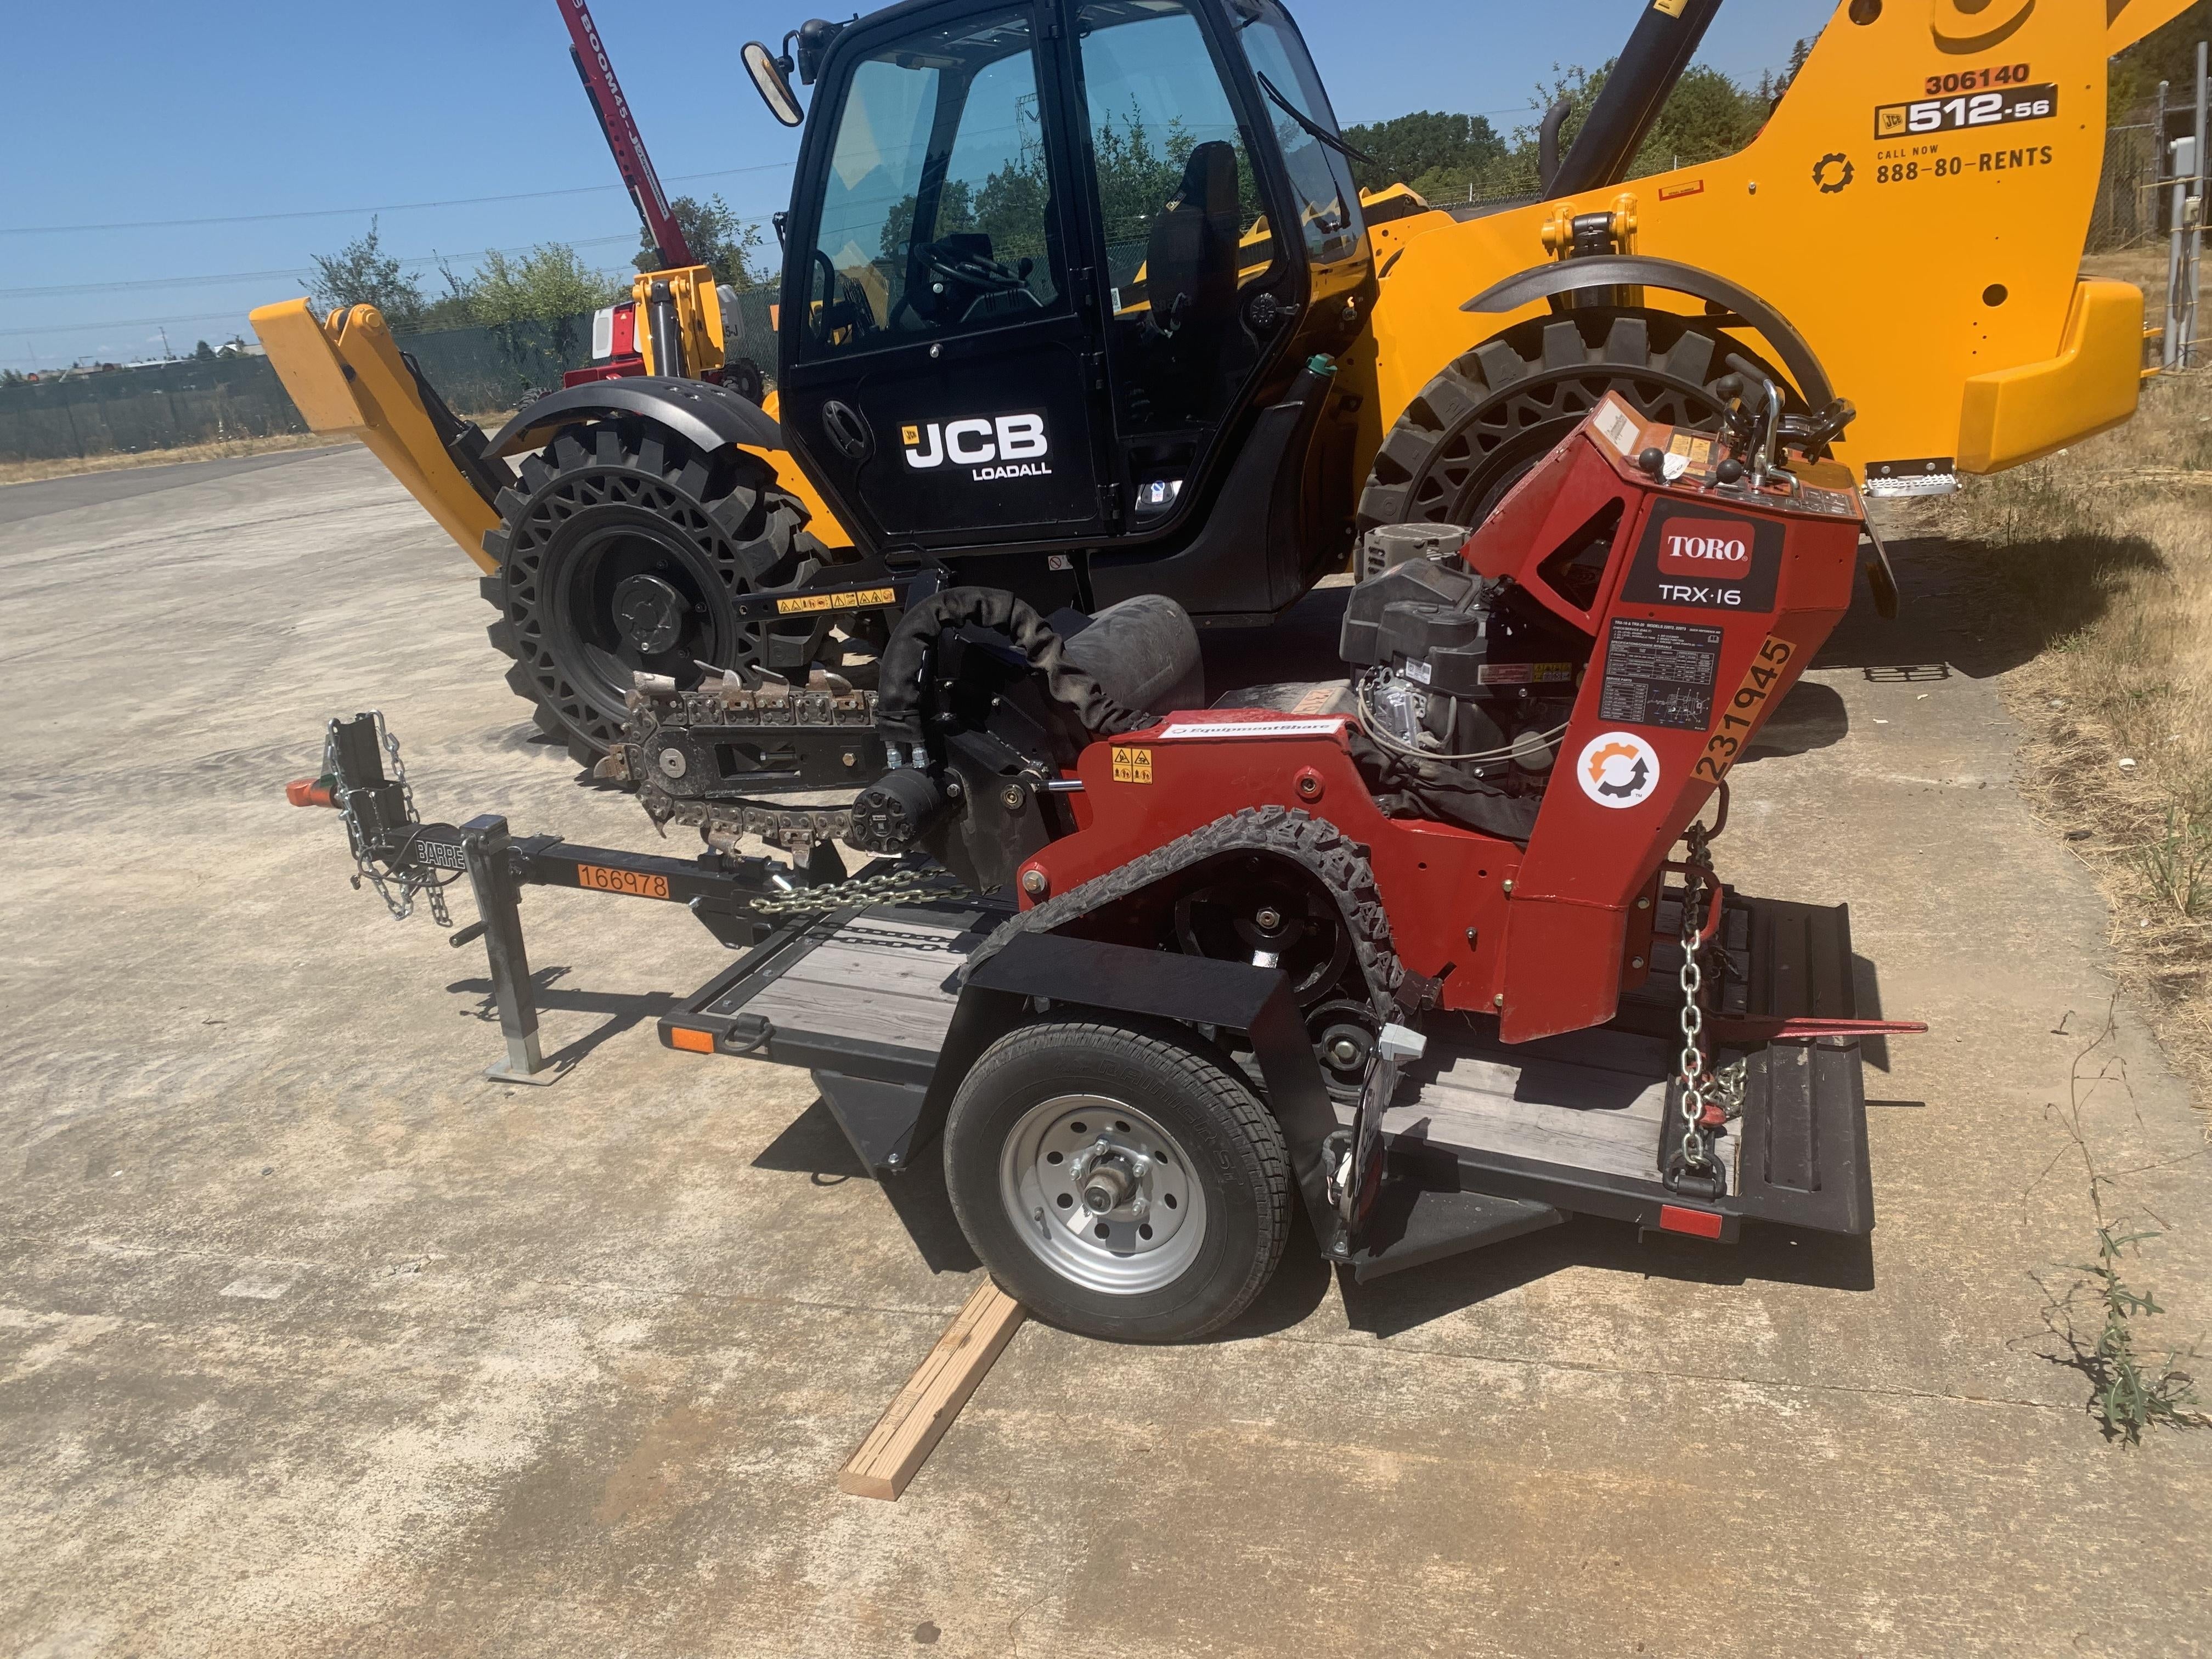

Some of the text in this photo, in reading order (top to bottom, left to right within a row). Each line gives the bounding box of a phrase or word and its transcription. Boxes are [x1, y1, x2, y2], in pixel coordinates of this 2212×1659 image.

[1926, 63, 2029, 95] 306140
[1886, 93, 2050, 132] JCB 512-56
[1876, 145, 2053, 184] 888-80-RENTS
[1877, 144, 1939, 160] CALL NOW
[905, 413, 1048, 469] JCB
[973, 462, 1052, 482] LOADALL
[1668, 535, 1746, 562] TORO
[1695, 640, 1790, 781] 231945
[1189, 723, 1330, 734] EquipmentShare
[415, 840, 466, 870] BARRE
[580, 865, 669, 897] 166978
